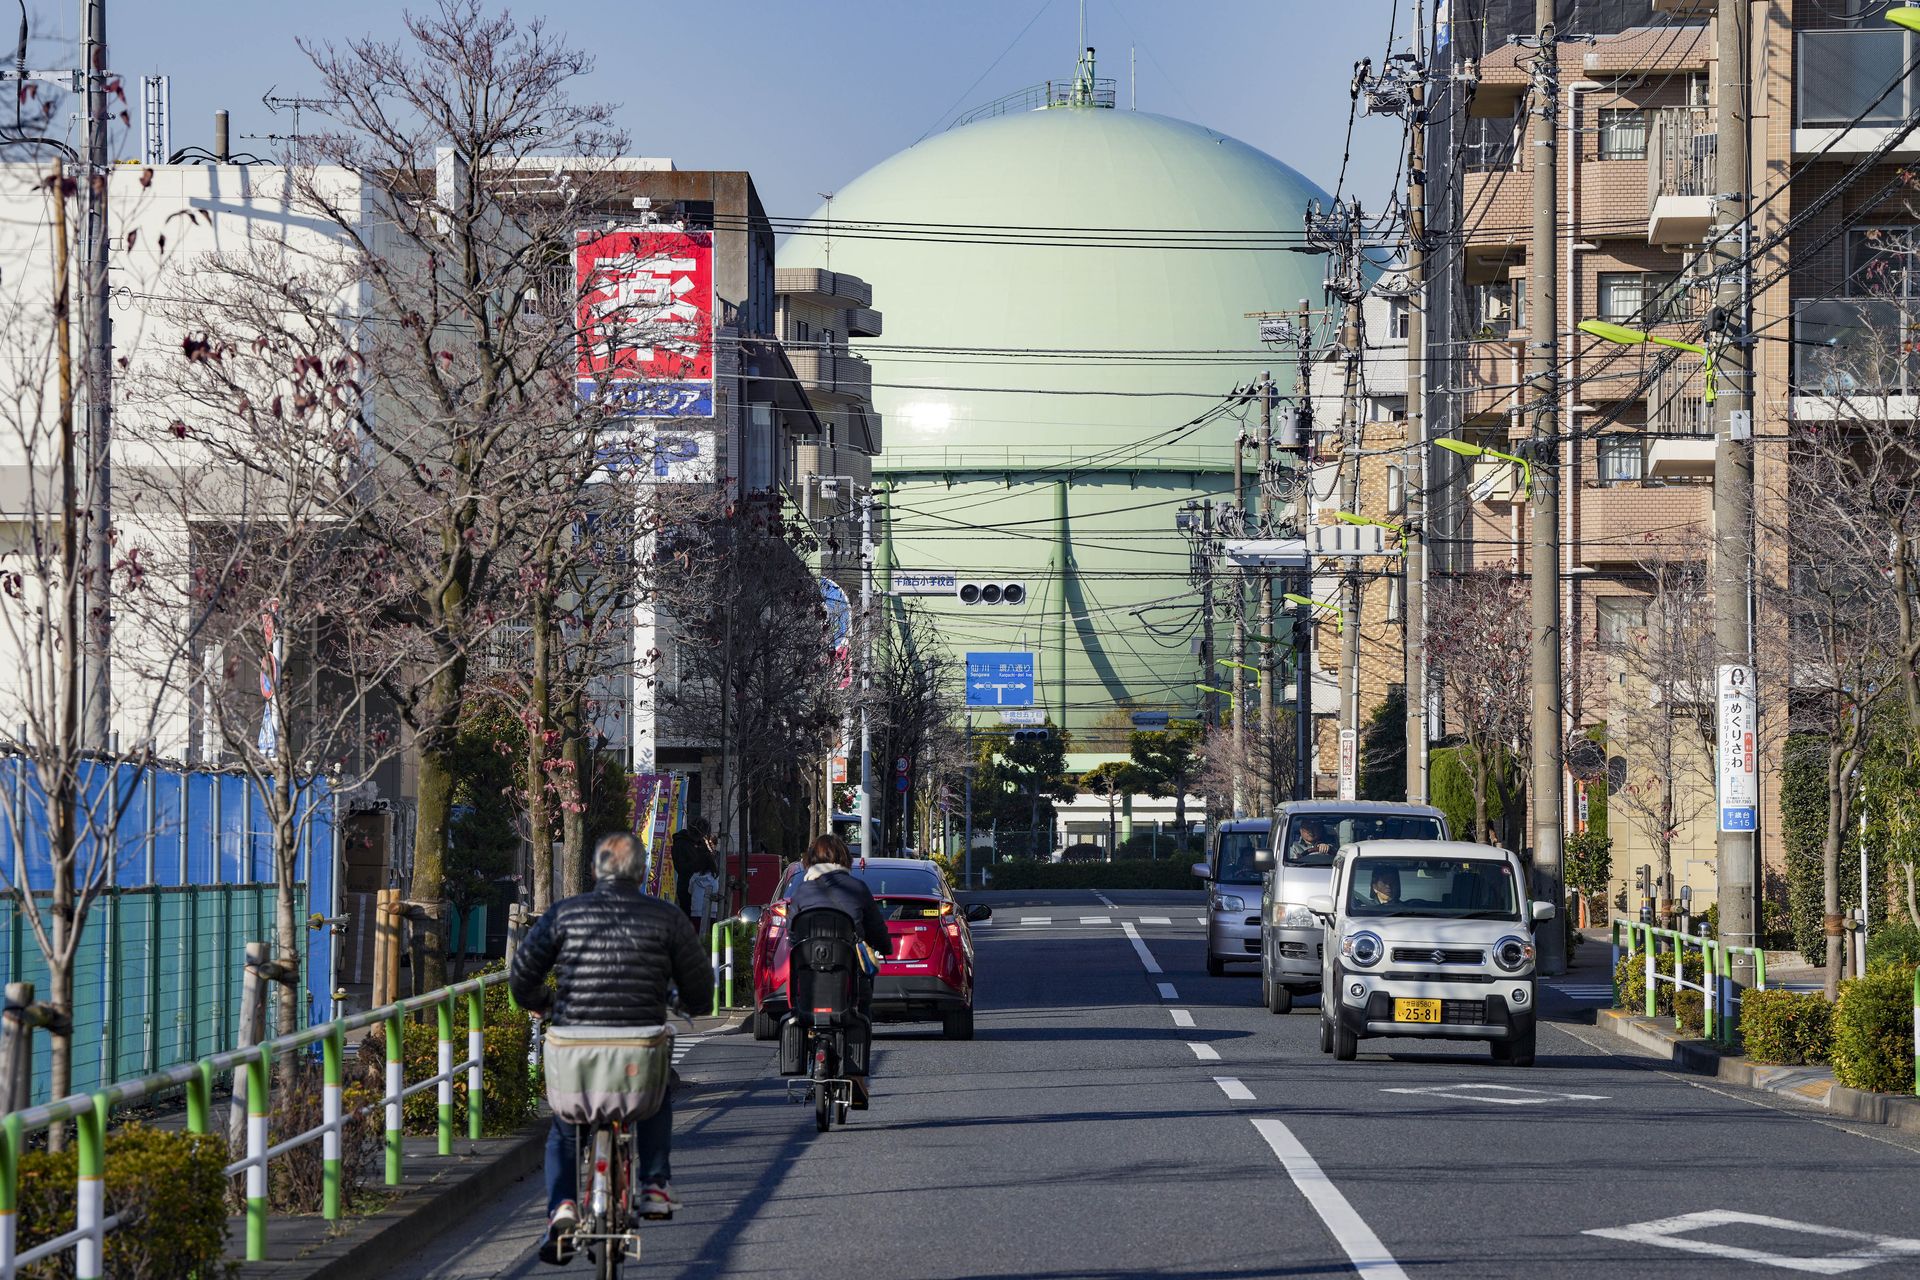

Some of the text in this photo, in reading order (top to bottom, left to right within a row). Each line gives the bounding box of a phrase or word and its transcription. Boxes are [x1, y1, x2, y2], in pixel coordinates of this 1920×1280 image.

[589, 252, 699, 362] 薬
[894, 576, 955, 587] 千歳台小学校西
[1730, 703, 1743, 768] めぐりさわ
[1580, 804, 1588, 820] 注意
[1727, 811, 1750, 819] 千歳台
[1405, 1008, 1437, 1020] 25-81
